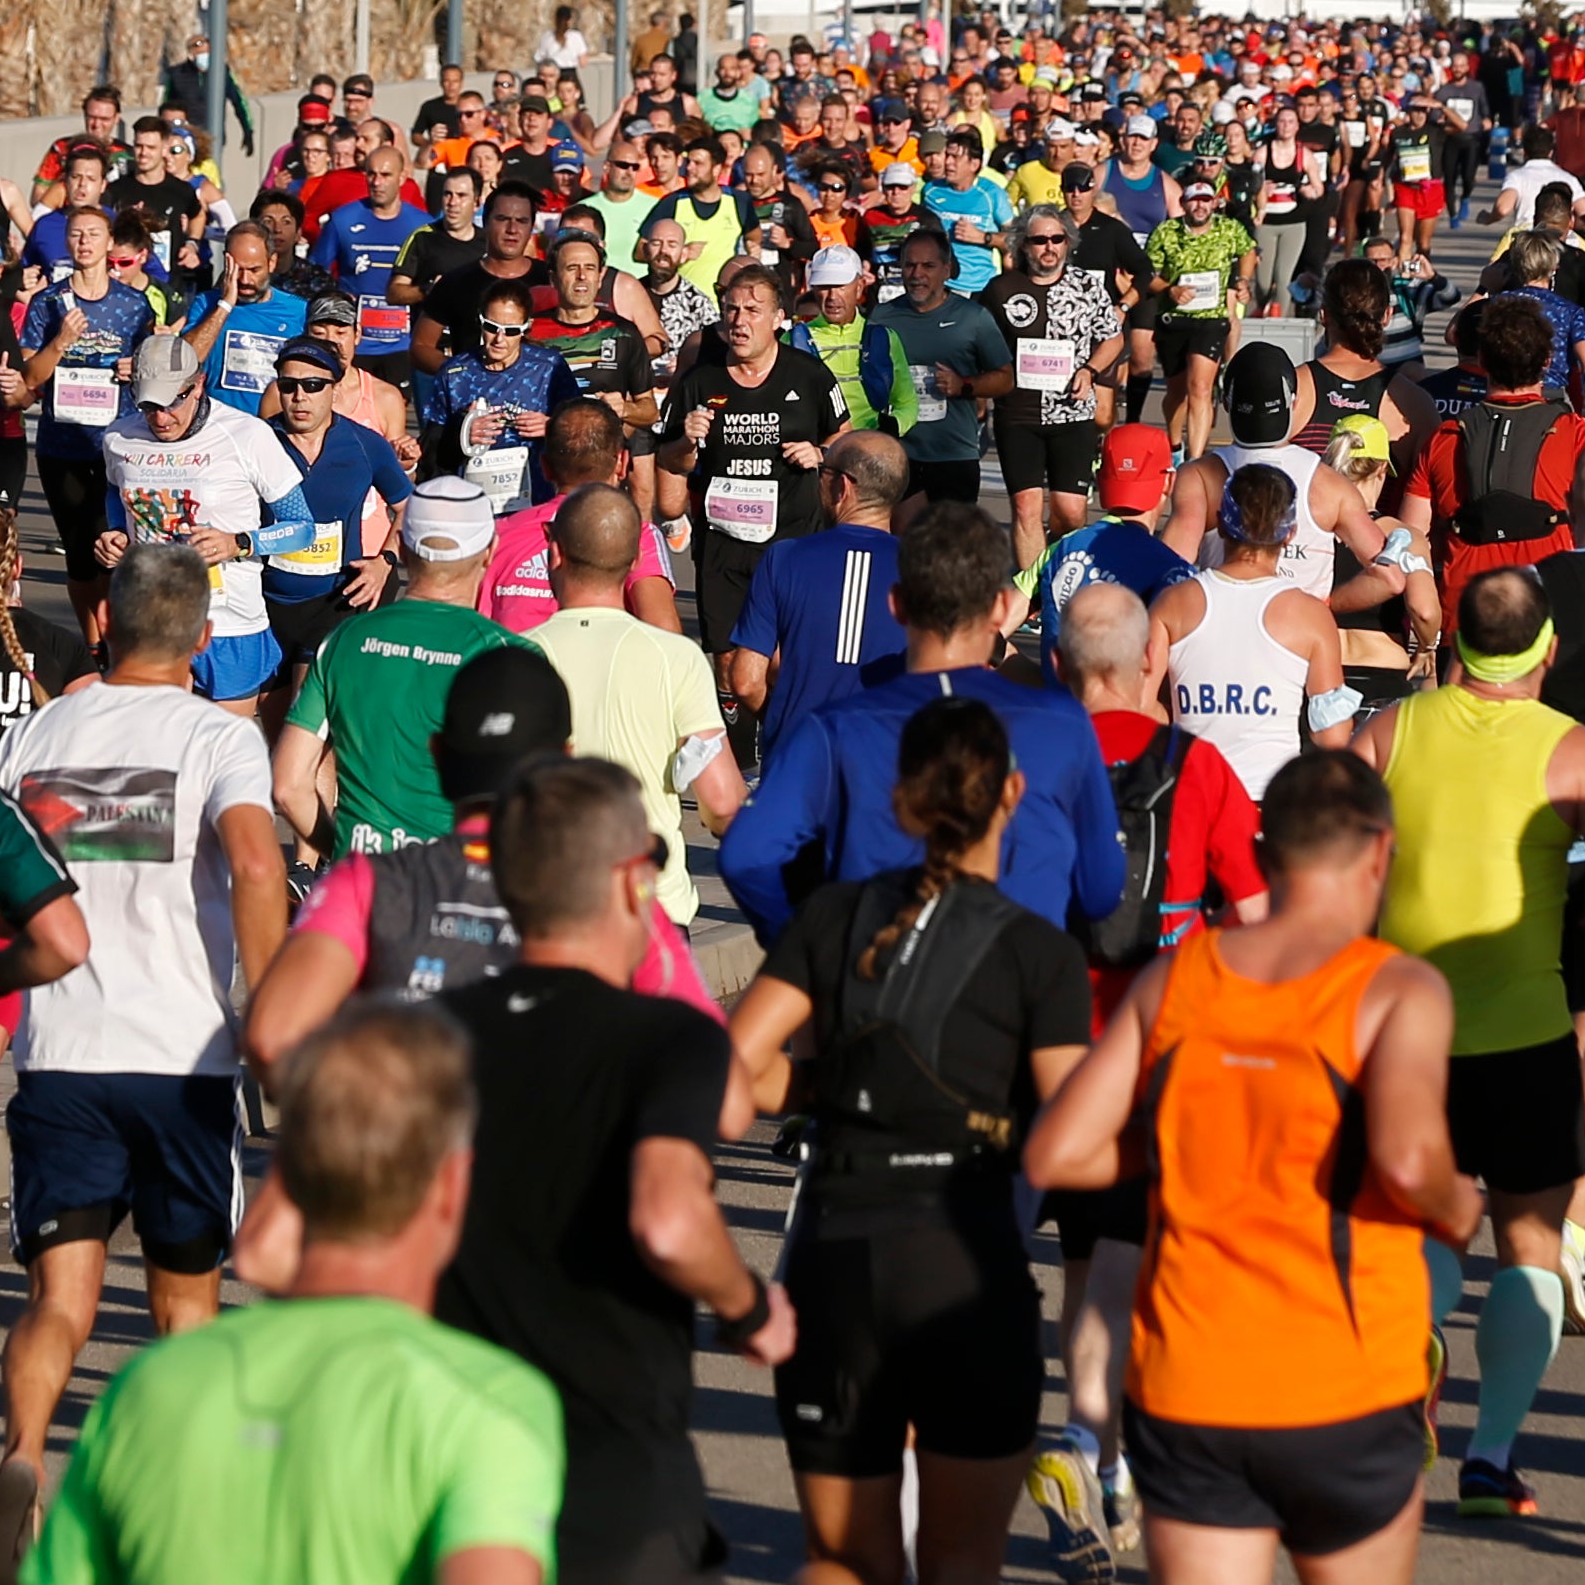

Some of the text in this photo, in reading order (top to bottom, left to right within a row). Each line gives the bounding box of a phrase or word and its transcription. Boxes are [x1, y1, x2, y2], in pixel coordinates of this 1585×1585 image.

[1041, 358, 1064, 368] 6741
[82, 389, 108, 400] 6694
[724, 413, 780, 425] WORLD
[723, 424, 780, 434] MARATHON
[723, 433, 781, 446] MAJORS
[146, 452, 211, 467] CARRERA
[140, 468, 188, 478] SOLIDARIA
[726, 458, 773, 476] JESUS
[491, 473, 518, 485] 7852
[736, 503, 764, 515] 6965
[360, 637, 462, 666] Jörgen Brynne
[1177, 683, 1278, 715] D.B.R.C.
